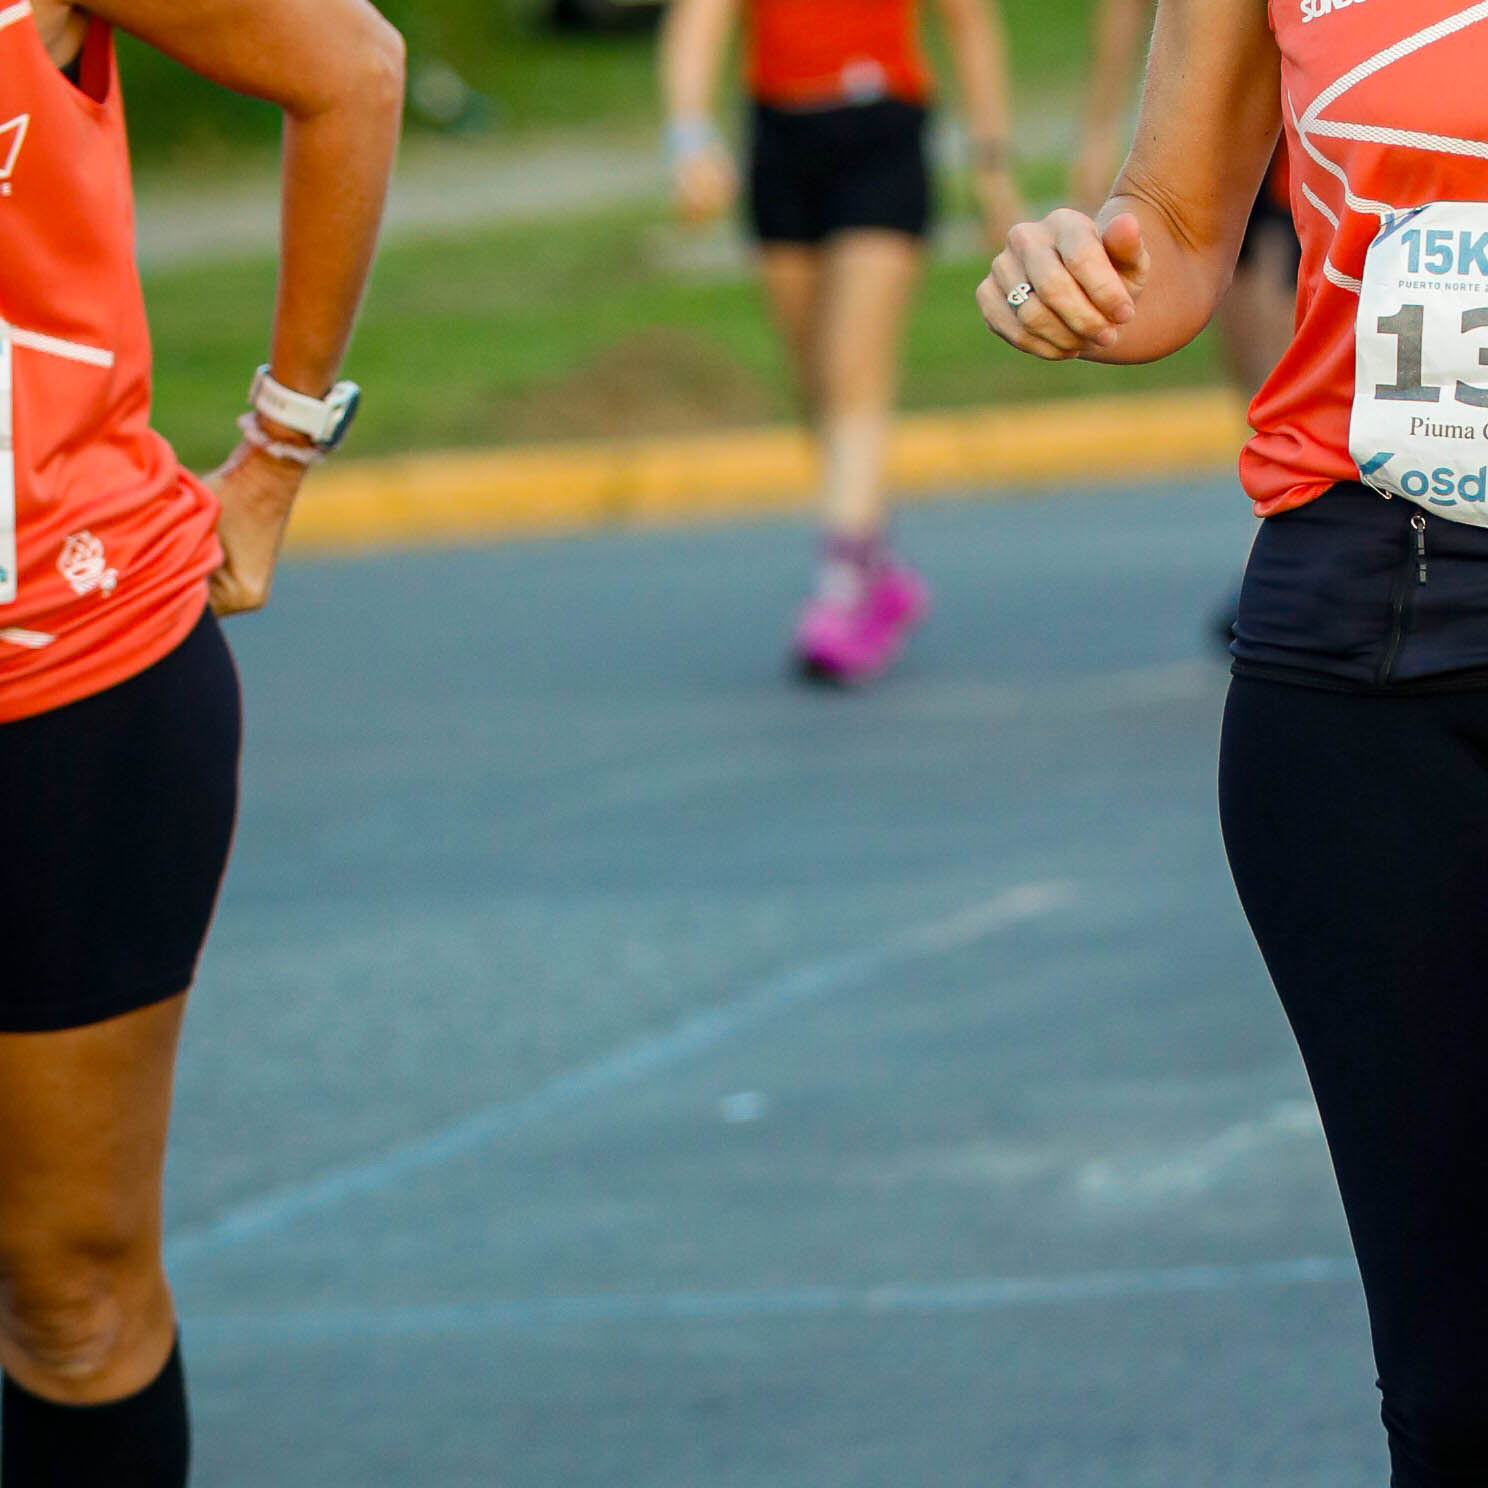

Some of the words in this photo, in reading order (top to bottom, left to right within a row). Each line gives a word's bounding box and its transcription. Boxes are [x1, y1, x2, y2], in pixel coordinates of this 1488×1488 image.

[1398, 280, 1441, 291] PUERTO
[1444, 282, 1481, 293] NORTE
[1409, 416, 1475, 441] Piuma
